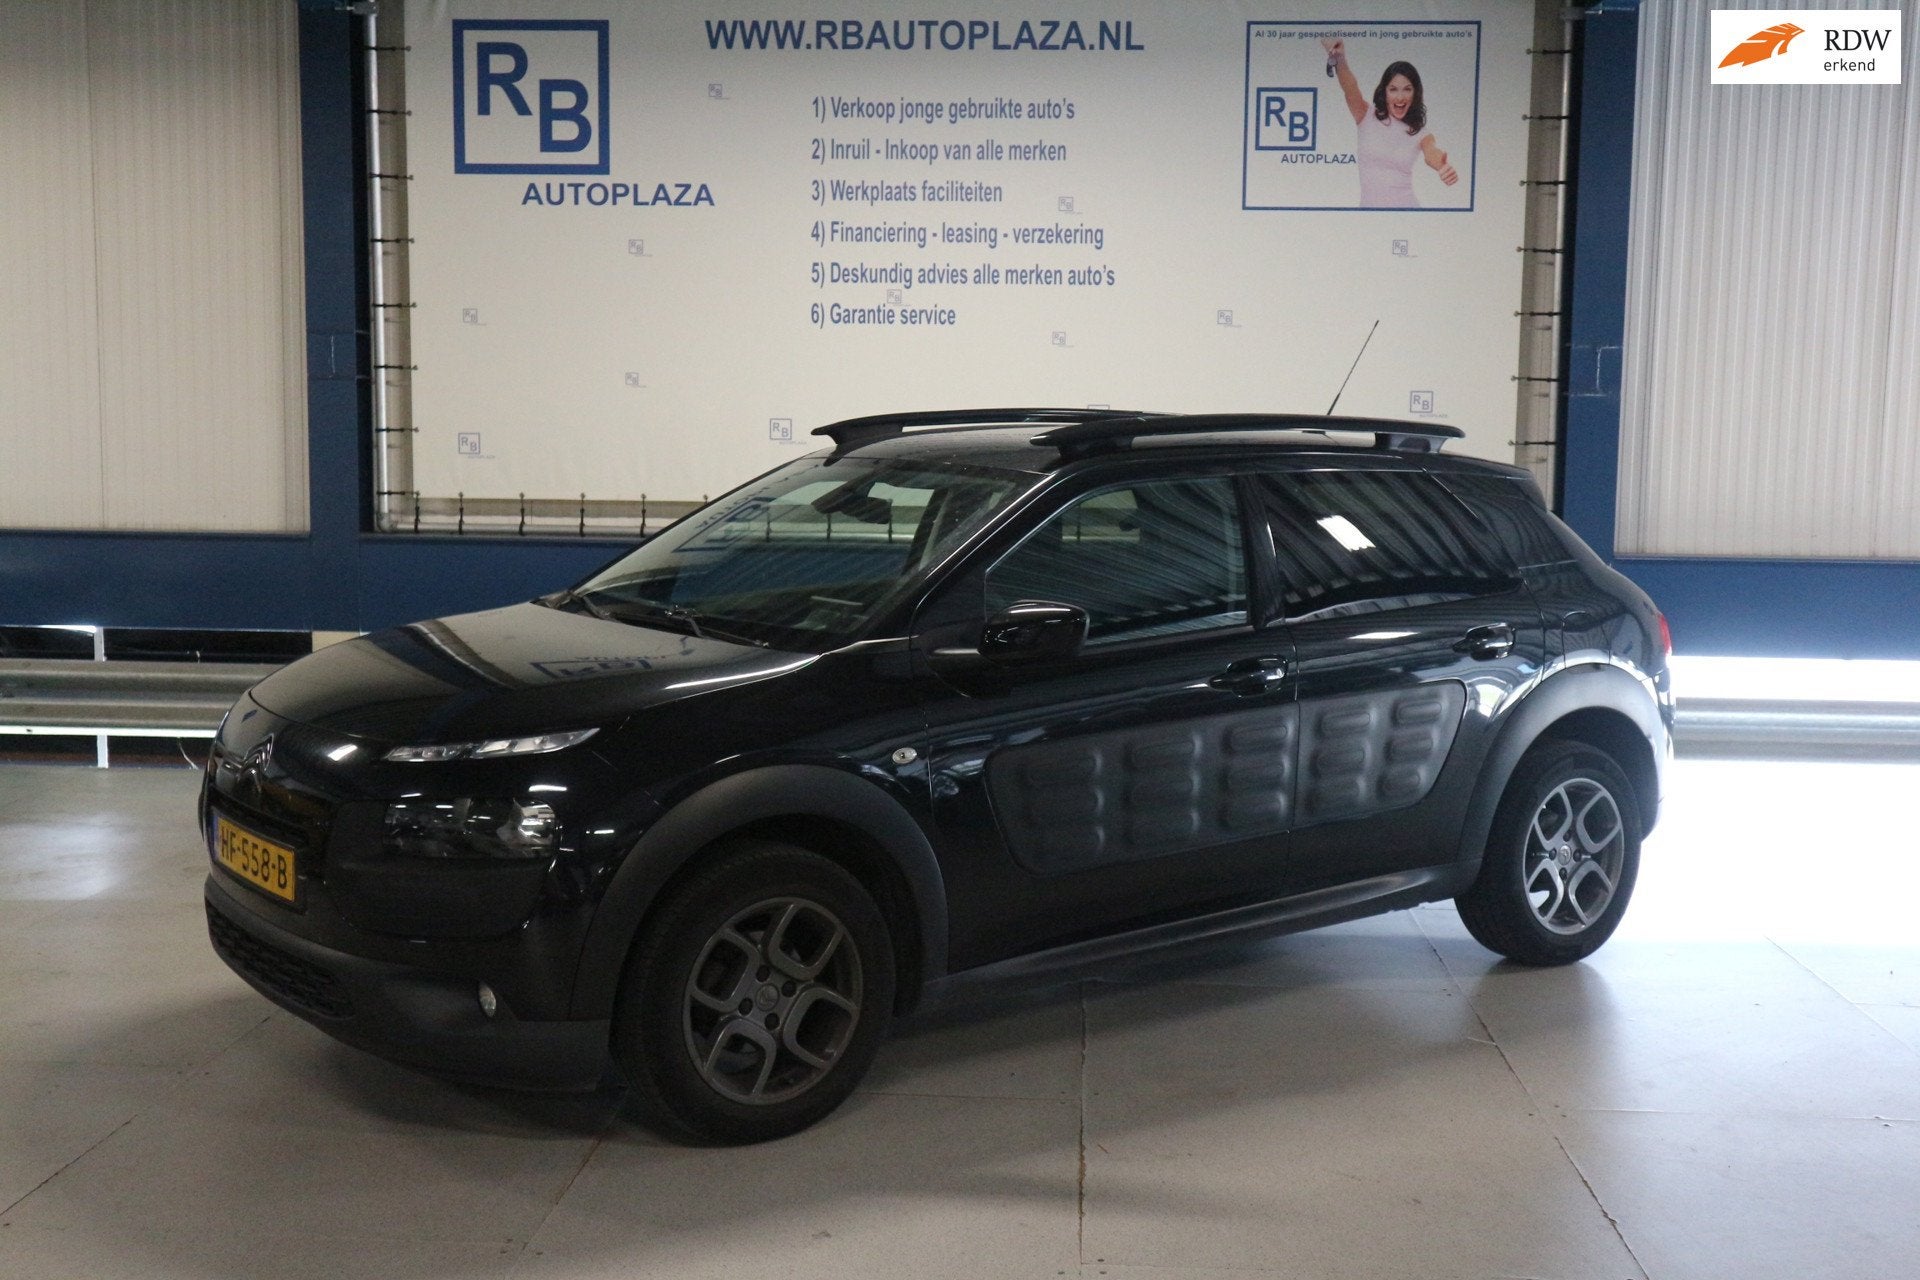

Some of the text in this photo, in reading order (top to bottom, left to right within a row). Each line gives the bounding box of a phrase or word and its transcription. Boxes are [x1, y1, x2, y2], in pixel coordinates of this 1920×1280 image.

[705, 20, 1145, 51] WWW.RBAUTOPLAZA.NL
[1279, 30, 1295, 39] jaar
[1298, 29, 1366, 39] gespecialiseerd
[1379, 30, 1399, 39] jong
[1402, 30, 1443, 39] gebruikte
[812, 97, 1075, 124] 1) Verkoop jonge gebruikte auto's
[811, 138, 826, 165] 2)
[831, 138, 870, 160] Inruil
[885, 139, 939, 165] Inkoop
[943, 144, 971, 161] van
[976, 139, 1004, 161] alle
[1008, 139, 1067, 161] merken
[1281, 154, 1356, 164] AUTOPLAZA
[521, 183, 715, 207] AUTOPLAZA
[811, 180, 1003, 206] 3) Werkplaats faciliteiten
[811, 221, 826, 247] 4)
[830, 221, 927, 248] Financiering
[942, 222, 998, 249] leasing
[1013, 222, 1104, 250] verzekering
[811, 262, 1115, 289] 5) Deskundig advies alle merken auto's
[811, 303, 956, 329] 6) Garantie service
[221, 826, 288, 889] HF-558-B
